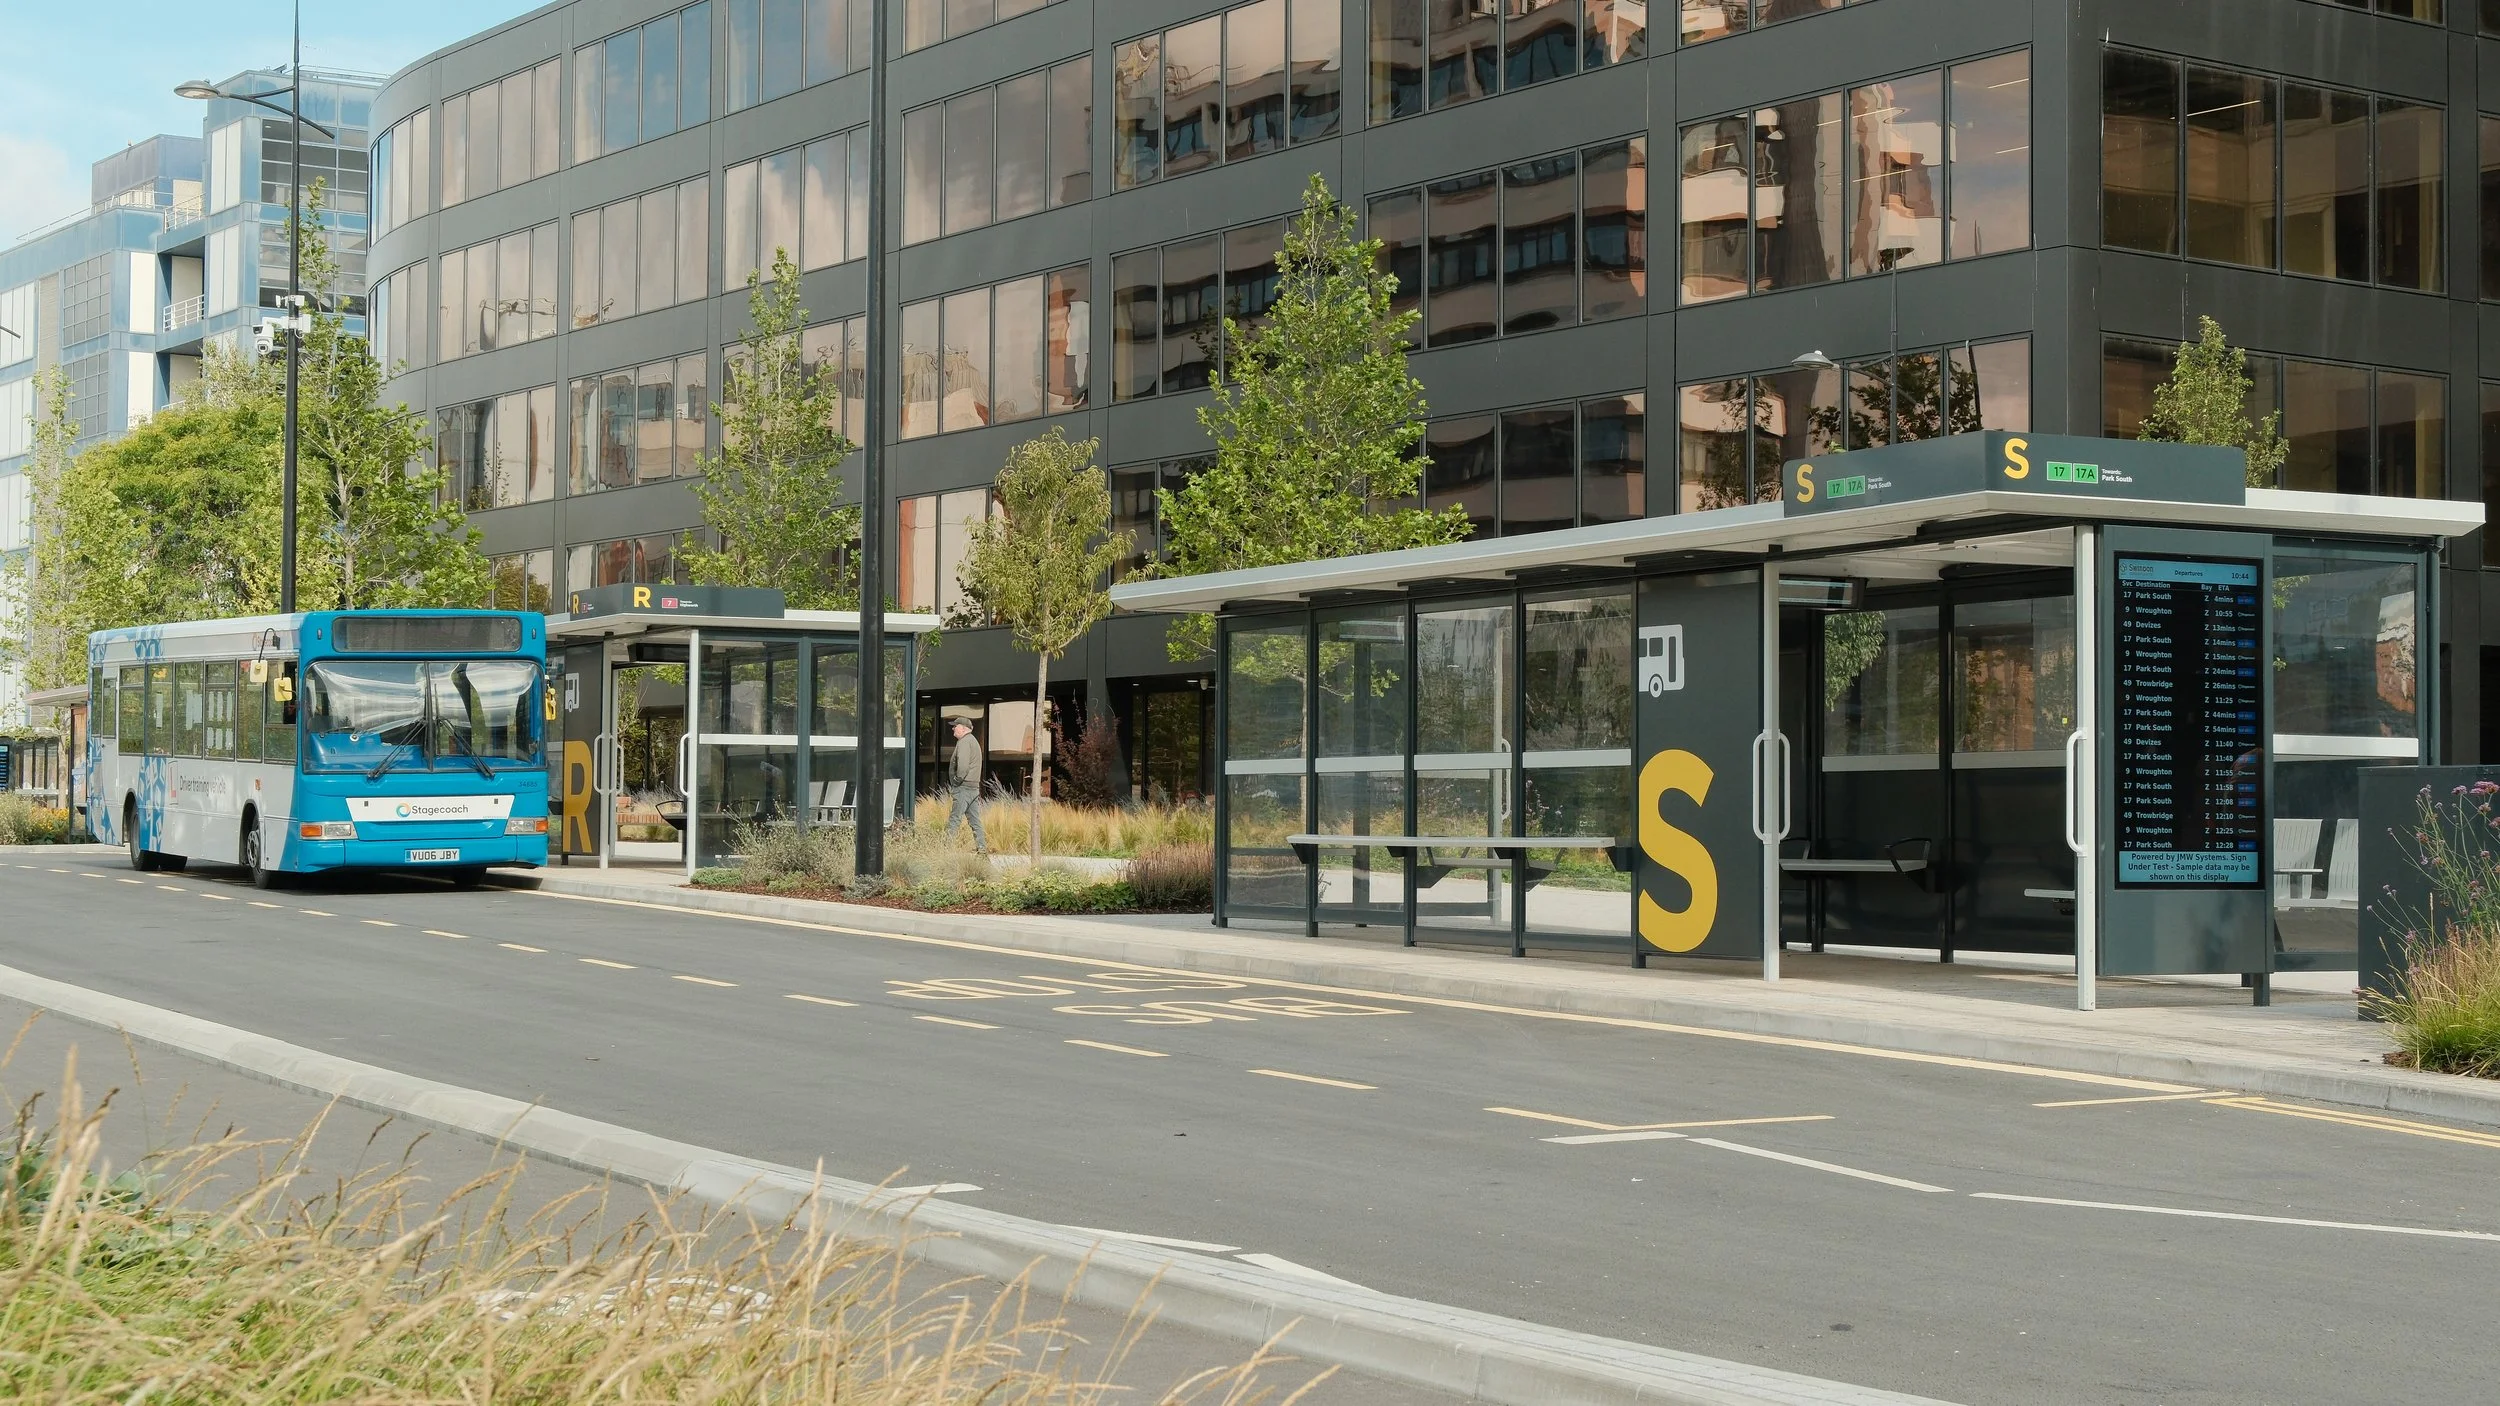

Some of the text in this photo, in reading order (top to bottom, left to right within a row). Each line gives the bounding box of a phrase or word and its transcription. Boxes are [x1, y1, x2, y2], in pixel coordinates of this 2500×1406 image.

[2004, 438, 2029, 479] S
[2054, 467, 2064, 477] 17
[2076, 468, 2095, 479] 17A
[1796, 464, 1814, 503] S
[1848, 481, 1862, 492] 17A
[1832, 484, 1840, 494] 17
[634, 587, 651, 608] R
[573, 594, 579, 614] R
[2136, 607, 2172, 615] Wroughton
[2136, 651, 2172, 659] Wroughton
[2136, 680, 2173, 688] Trowbridge
[2136, 695, 2172, 703] Wroughton
[2136, 768, 2172, 776] Wroughton
[563, 740, 592, 852] R
[412, 805, 469, 816] Stagecoach
[2136, 812, 2173, 820] Trowbridge
[2136, 827, 2172, 835] Wroughton
[412, 850, 457, 860] VU06 JBY
[1639, 749, 1718, 952] S
[2166, 854, 2175, 862] by
[2176, 854, 2193, 862] JMW
[2196, 854, 2229, 862] Systems.
[2230, 854, 2246, 862] Sign
[2176, 864, 2203, 872] Sample
[2202, 874, 2229, 882] display
